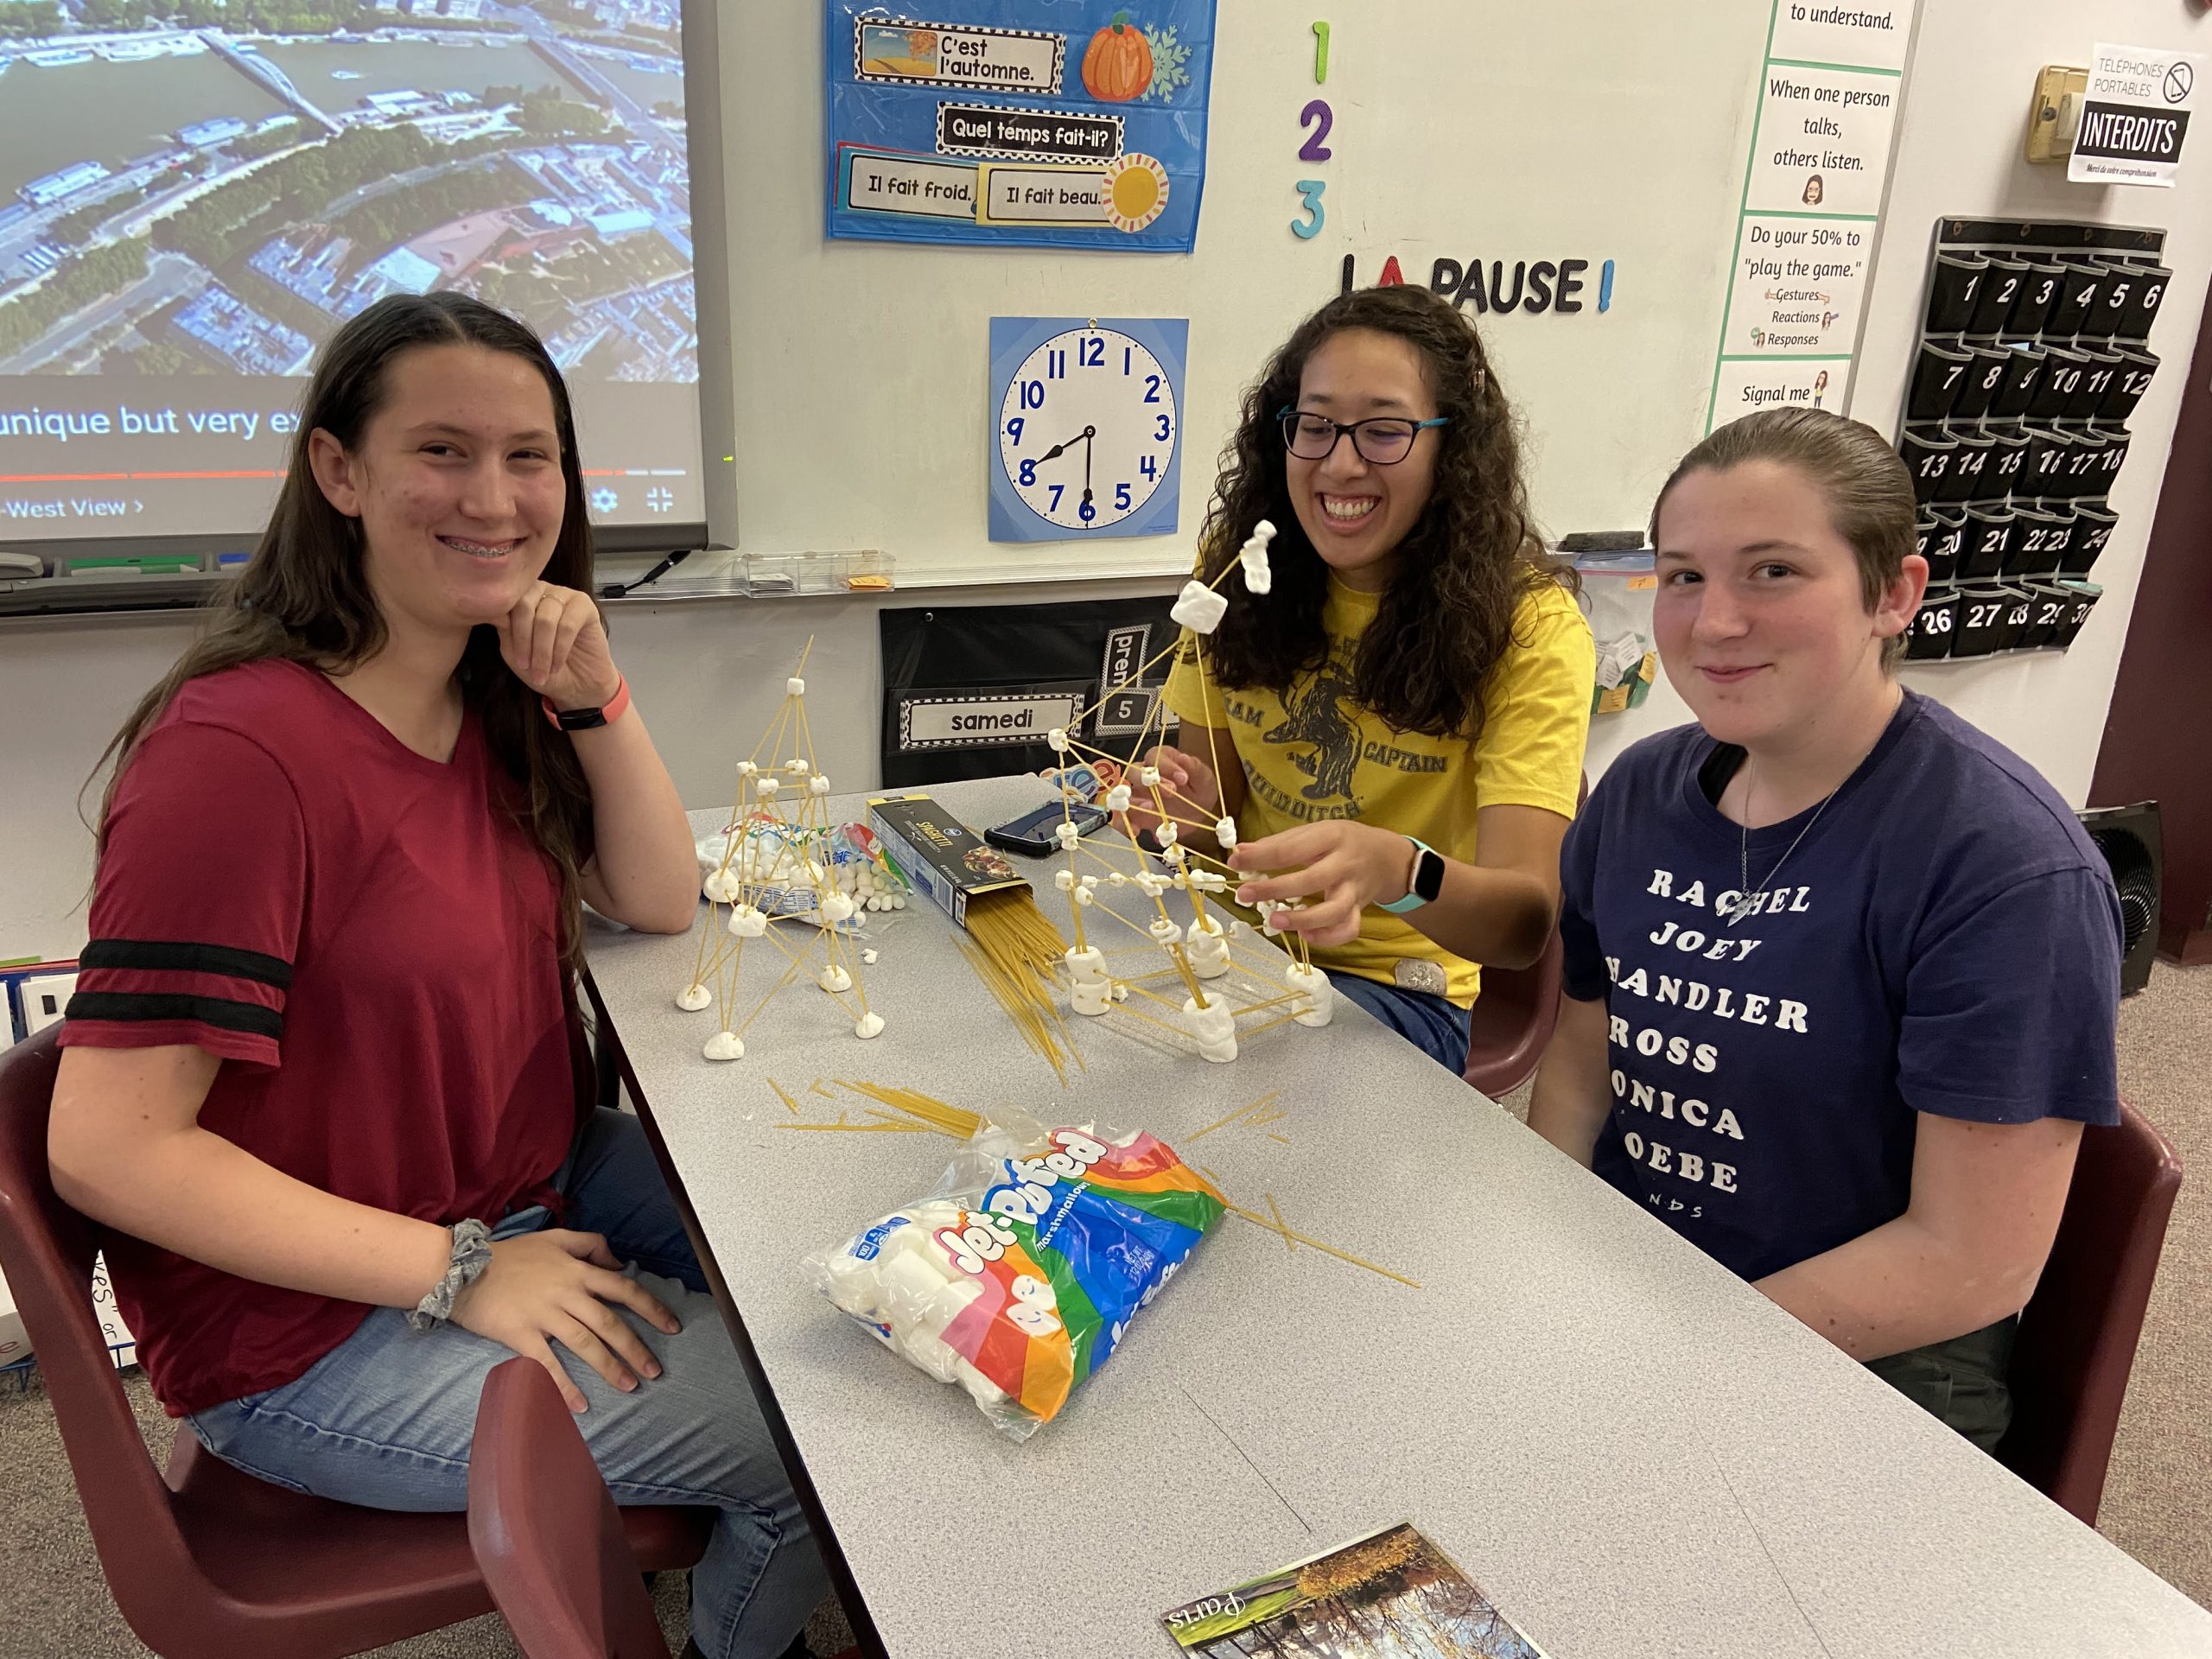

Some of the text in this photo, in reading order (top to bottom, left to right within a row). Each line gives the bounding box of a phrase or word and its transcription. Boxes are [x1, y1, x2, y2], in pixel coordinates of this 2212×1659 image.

[1791, 3, 1894, 30] to understand.
[941, 35, 988, 56] C'est
[1313, 22, 1330, 83] 1
[940, 60, 1035, 81] l'automne.
[1770, 79, 1890, 108] When one person
[2094, 79, 2152, 97] PORTABLES
[952, 118, 1109, 148] Quel temps fait-il?
[1299, 99, 1333, 161] 2
[1803, 118, 1842, 139] talks,
[2082, 111, 2177, 154] INTERDITS
[1774, 149, 1864, 171] others listen.
[868, 175, 972, 201] Il fait froid.
[1007, 187, 1102, 206] Il fait beau.
[1291, 181, 1325, 238] 3
[1751, 226, 1860, 248] Do your 50% to
[1745, 257, 1861, 281] "play the game."
[1776, 289, 1819, 303] Gestures
[1964, 276, 2161, 308] 1 2 3 4 5 6
[1771, 311, 1820, 323] Reactions
[1079, 338, 1104, 366] 12
[1768, 334, 1819, 348] Responses
[1049, 350, 1065, 378] 11
[1124, 347, 1130, 375] 1
[1144, 375, 1160, 403] 2
[1943, 366, 2152, 395] 7 8 9 10 11 12
[1020, 380, 1044, 410] 10
[1742, 385, 1810, 406] Signal me
[120, 406, 179, 433] but
[187, 413, 259, 440] very
[1007, 418, 1025, 446] 9
[1154, 415, 1169, 442] 3
[1019, 459, 1037, 486] 8
[1140, 456, 1156, 481] 4
[1920, 448, 2125, 477] 13 14 15 16 17 18
[71, 497, 126, 516] View
[1048, 485, 1065, 512] 7
[1078, 499, 1096, 521] 6
[1114, 484, 1131, 510] 5
[1935, 530, 1961, 556] 20
[1980, 528, 2010, 552] 21
[2022, 529, 2048, 551] 22
[2044, 528, 2072, 551] 23
[1922, 608, 1952, 635] 26
[1967, 604, 2002, 627] 27
[951, 709, 1033, 731] samedi
[1118, 700, 1134, 718] 5
[1363, 741, 1447, 773] CAPTAIN
[916, 822, 953, 848] SPAGHETTI
[1647, 869, 1810, 916] RACHEL
[1649, 921, 1762, 961] JOEY
[1605, 957, 1808, 1033] HANDLER
[1609, 1015, 1718, 1073] ROSS
[1611, 1069, 1744, 1141] ONICA
[1624, 1132, 1738, 1193] OEBE
[103, 1324, 117, 1339] or
[1168, 1591, 1246, 1630] Paris
